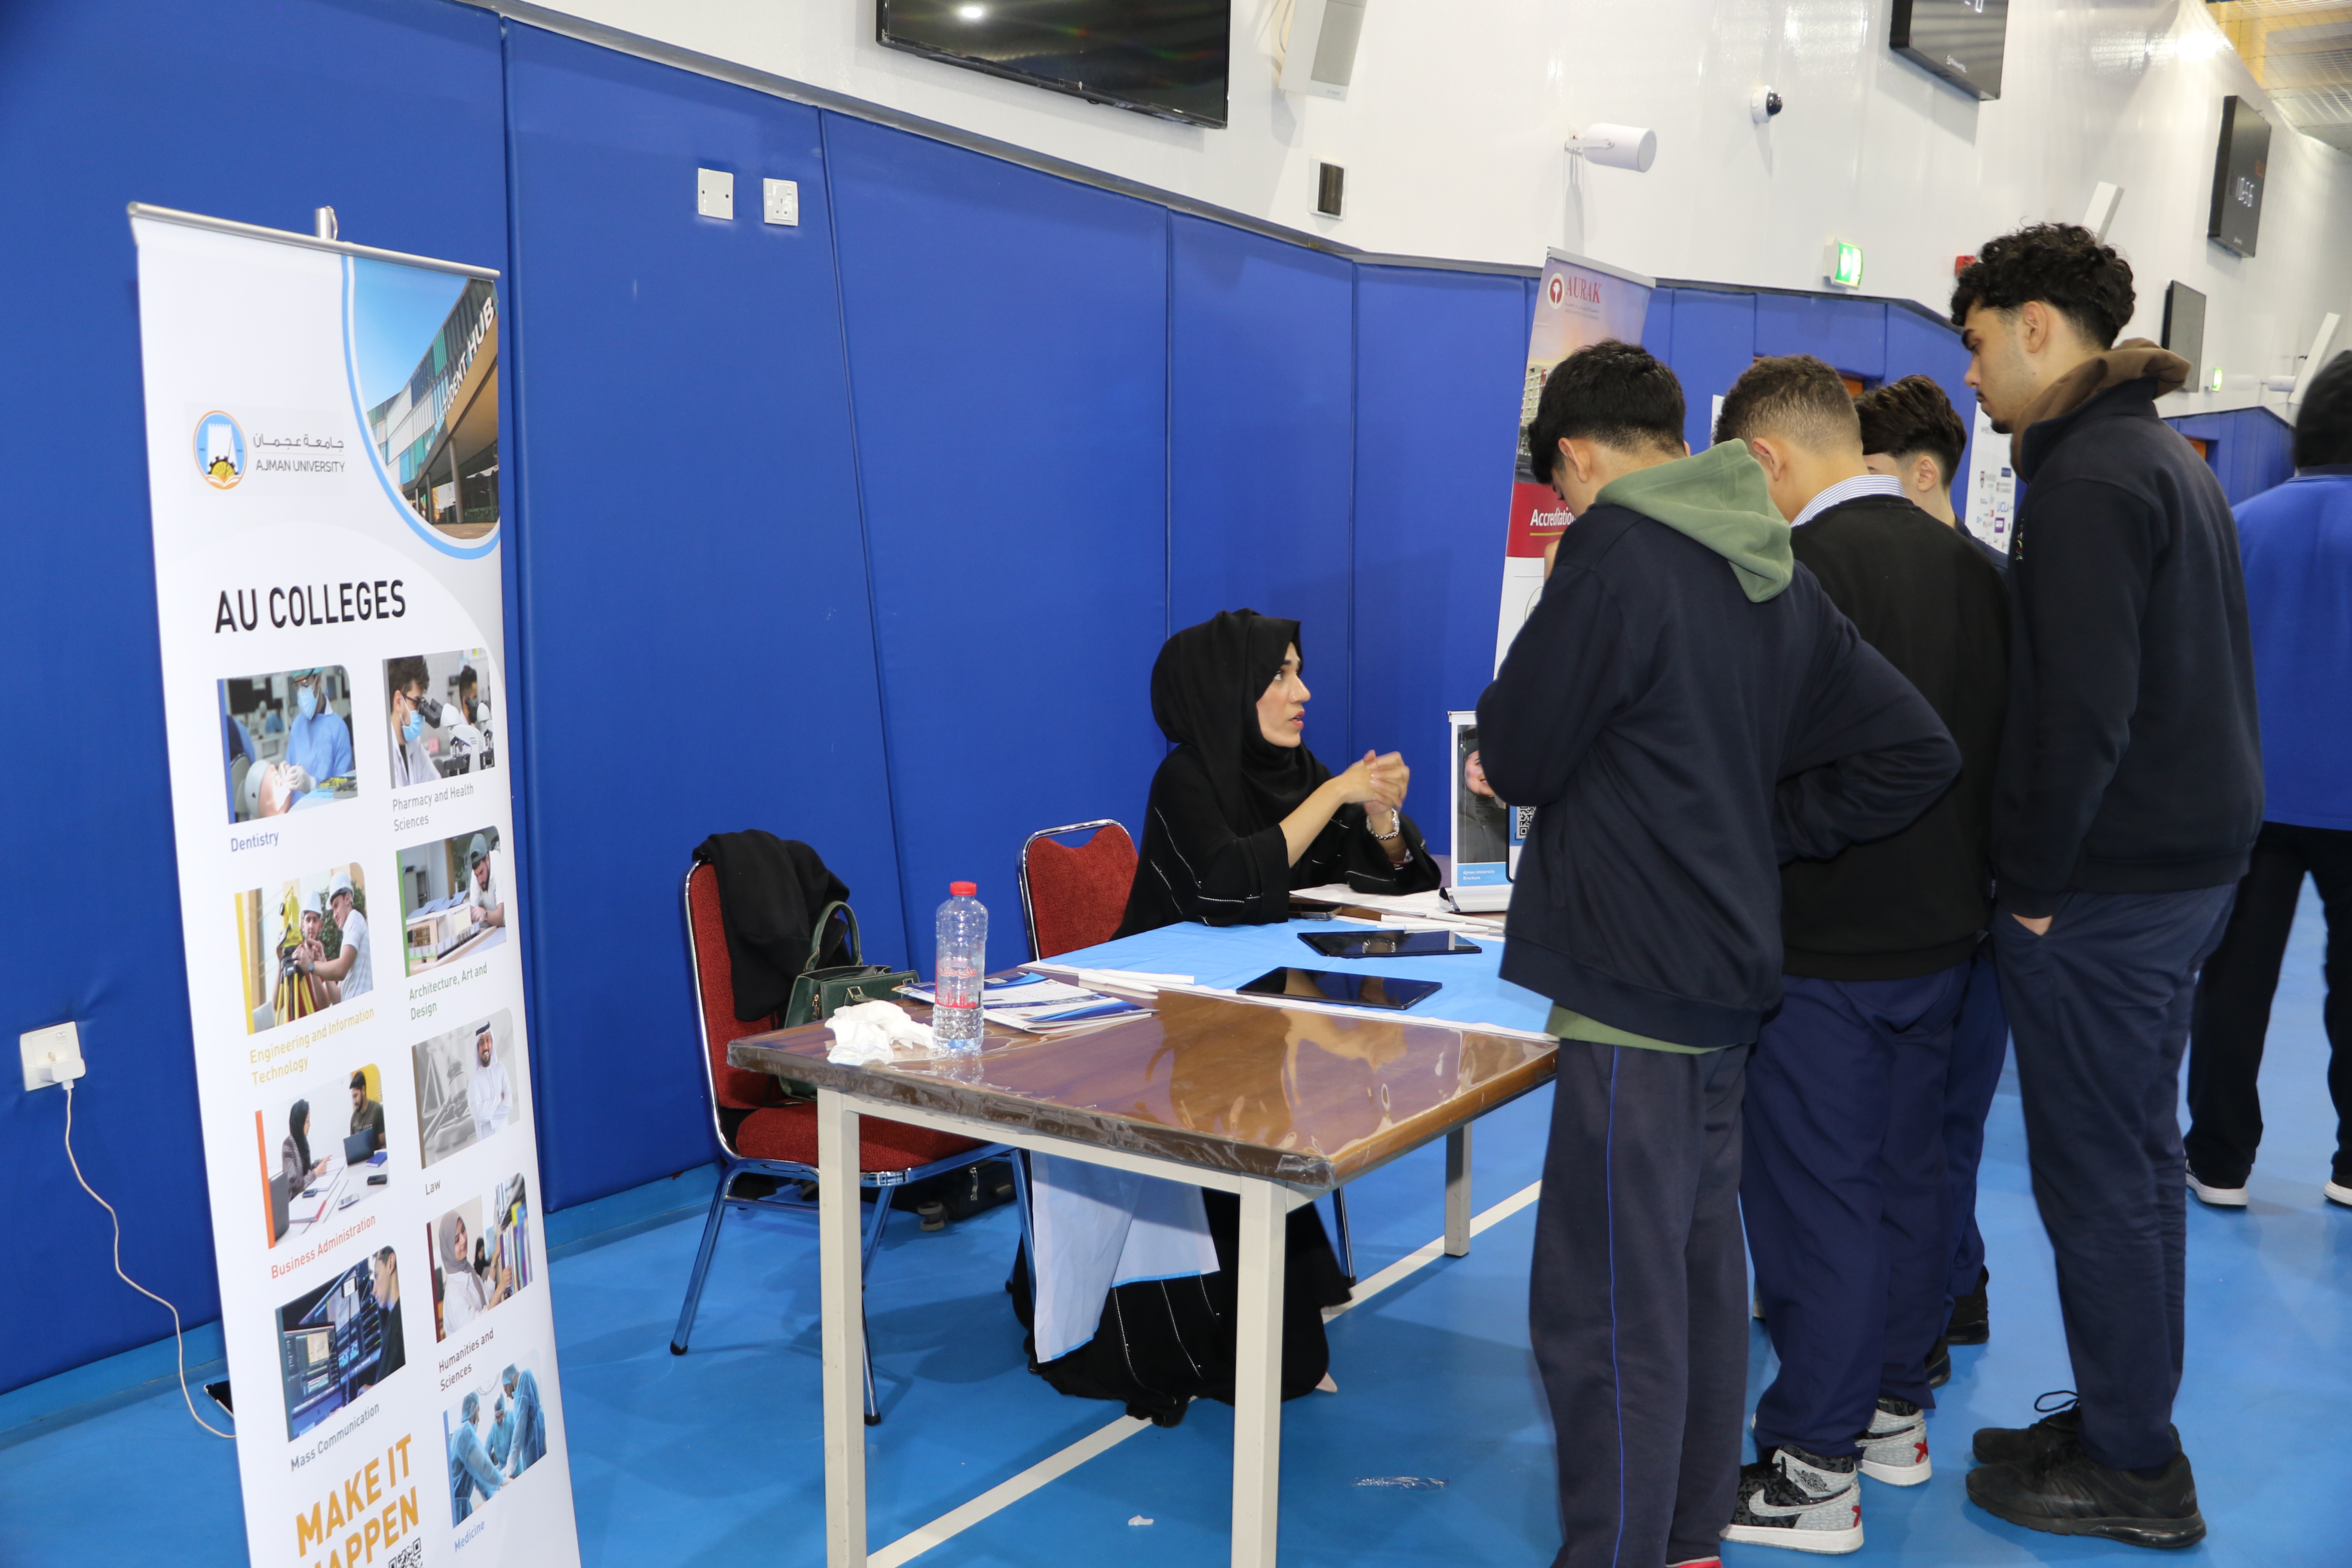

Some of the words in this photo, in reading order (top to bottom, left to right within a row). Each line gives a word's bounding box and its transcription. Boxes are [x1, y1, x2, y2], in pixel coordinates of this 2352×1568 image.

[1565, 276, 1602, 303] AURAK
[468, 297, 494, 363] HUB
[253, 433, 302, 450] عجمان
[303, 433, 344, 452] جامعة
[256, 459, 291, 471] AJMAN
[293, 460, 345, 472] UNIVERSITY
[215, 588, 258, 634] AU
[269, 579, 406, 628] COLLEGES
[392, 793, 432, 812] Pharmacy
[435, 790, 448, 802] and
[450, 783, 474, 799] Health
[394, 814, 429, 832] Sciences
[230, 831, 279, 852] Dentistry
[409, 974, 460, 1001] Architecture,
[461, 968, 473, 982] Art
[475, 962, 487, 977] and
[410, 1002, 437, 1020] Design
[250, 1034, 310, 1064] Engineering
[312, 1023, 327, 1042] and
[328, 1007, 375, 1033] Information
[251, 1055, 309, 1086] Technology
[425, 1180, 441, 1196] Law
[271, 1250, 315, 1279] Business
[318, 1215, 376, 1257] Administration
[438, 1339, 479, 1373] Humanities
[481, 1327, 494, 1345] and
[440, 1363, 472, 1391] Sciences
[291, 1449, 316, 1472] Mass
[318, 1403, 380, 1455] Communication
[296, 1456, 382, 1558] MAKE
[387, 1433, 411, 1488] IT
[315, 1485, 419, 1568] PPEN
[454, 1520, 485, 1553] Medicine
